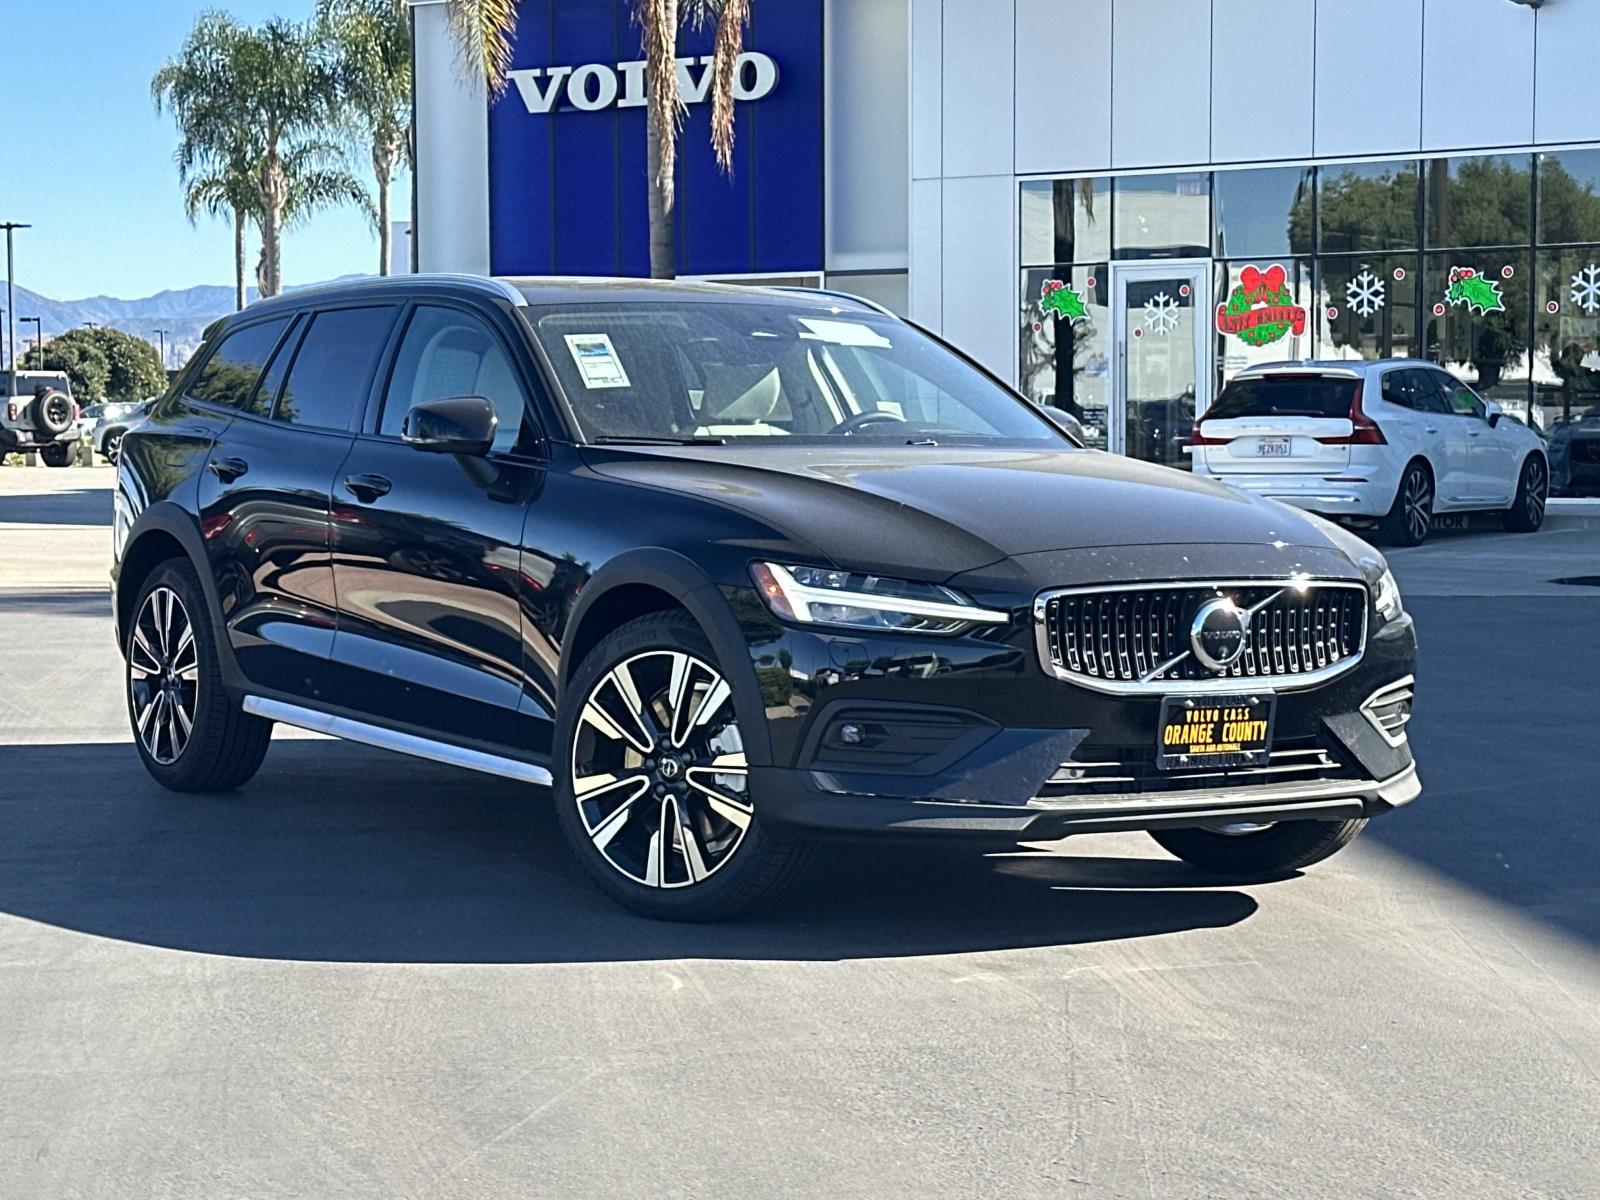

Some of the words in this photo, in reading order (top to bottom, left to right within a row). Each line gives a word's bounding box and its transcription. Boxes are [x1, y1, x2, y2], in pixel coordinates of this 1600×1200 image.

[1186, 709, 1219, 723] VOLVO
[1164, 724, 1214, 745] ORANGE
[1222, 720, 1267, 742] COUNTY
